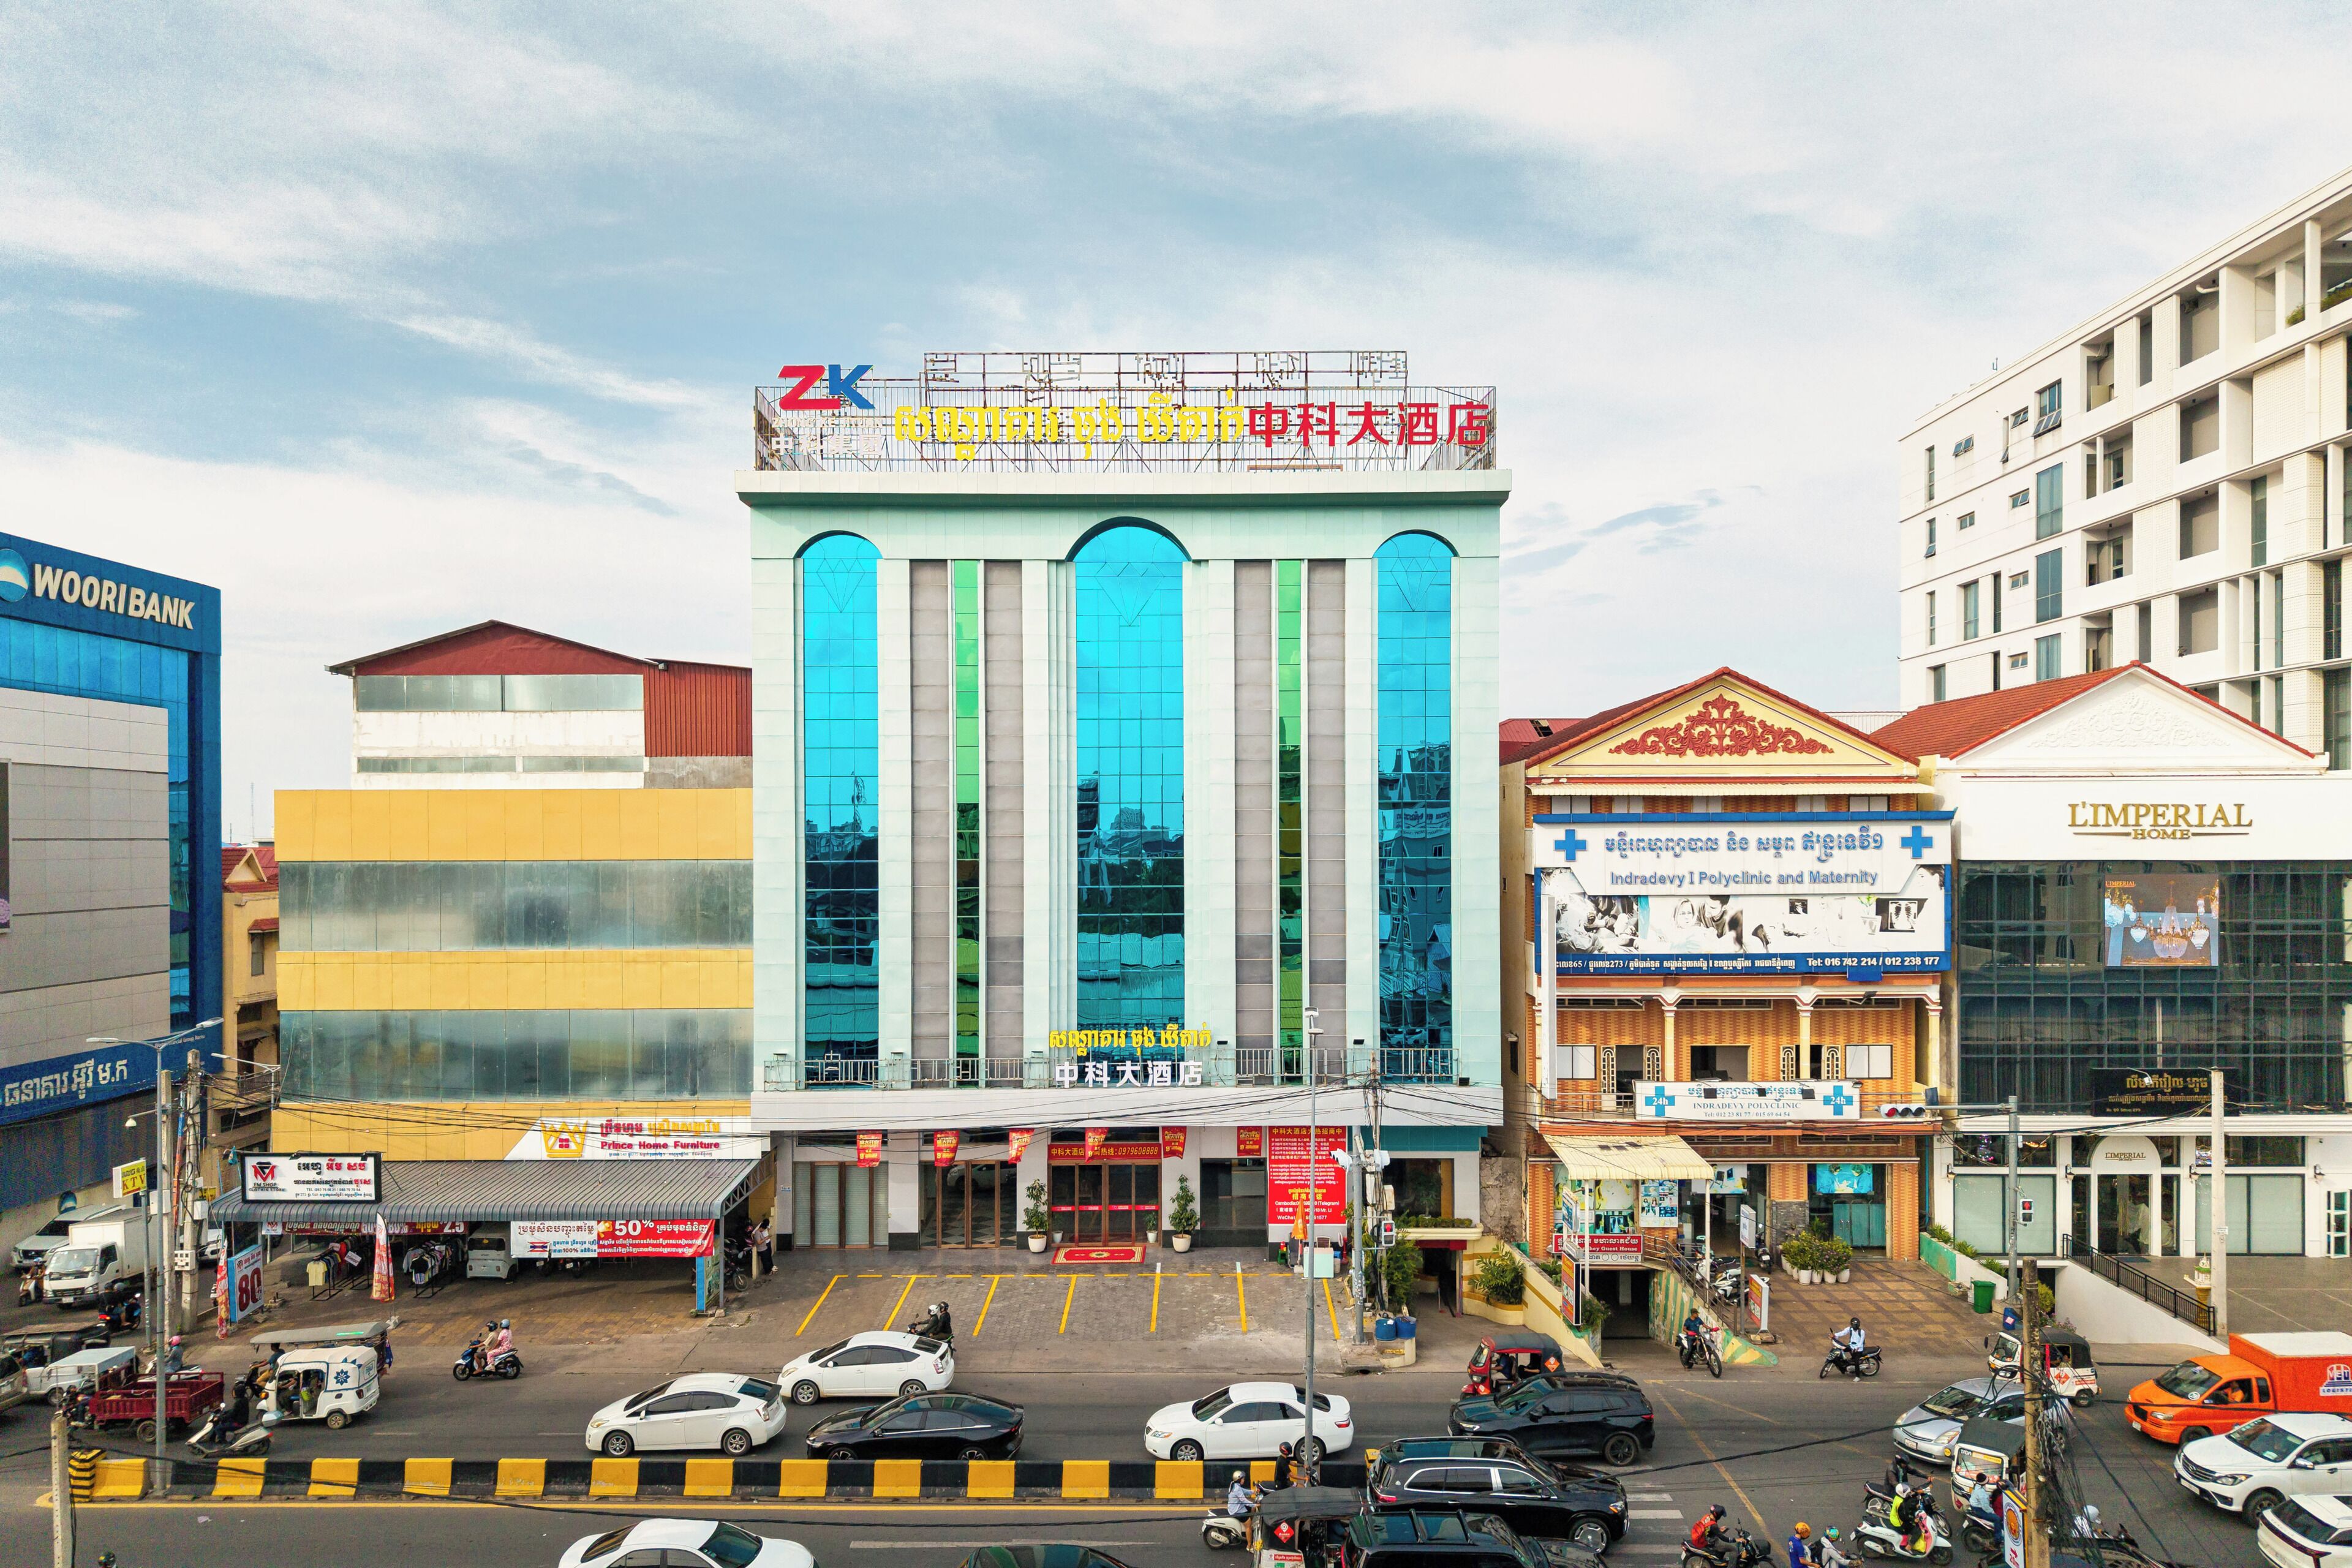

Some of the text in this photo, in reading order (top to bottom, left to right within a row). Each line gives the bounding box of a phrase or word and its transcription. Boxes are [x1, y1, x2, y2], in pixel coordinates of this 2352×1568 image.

[1248, 400, 1489, 448] 中科大酒店
[771, 434, 883, 456] 中科集团
[2068, 801, 2253, 827] L'IMPERIAL
[2132, 829, 2191, 840] HOME
[1610, 871, 1686, 888] Indradevy
[1699, 870, 1772, 886] Polyclinic
[1777, 871, 1804, 884] and
[1809, 870, 1878, 886] Maternity
[1807, 957, 1822, 967] Tel:
[1825, 957, 1840, 967] 016
[1842, 957, 1858, 967] 742
[1860, 957, 1877, 967] 214
[1885, 956, 1901, 966] 012
[1903, 956, 1920, 966] 238
[1922, 956, 1939, 966] 177
[1055, 1060, 1202, 1088] 中科大酒店
[4, 1071, 69, 1107] ធនាគារ
[1652, 1097, 1668, 1106] 24h
[1830, 1096, 1846, 1105] 24h
[600, 1140, 720, 1150] Prince Home Furniture
[123, 1174, 146, 1191] KTV
[615, 1219, 654, 1236] 50%
